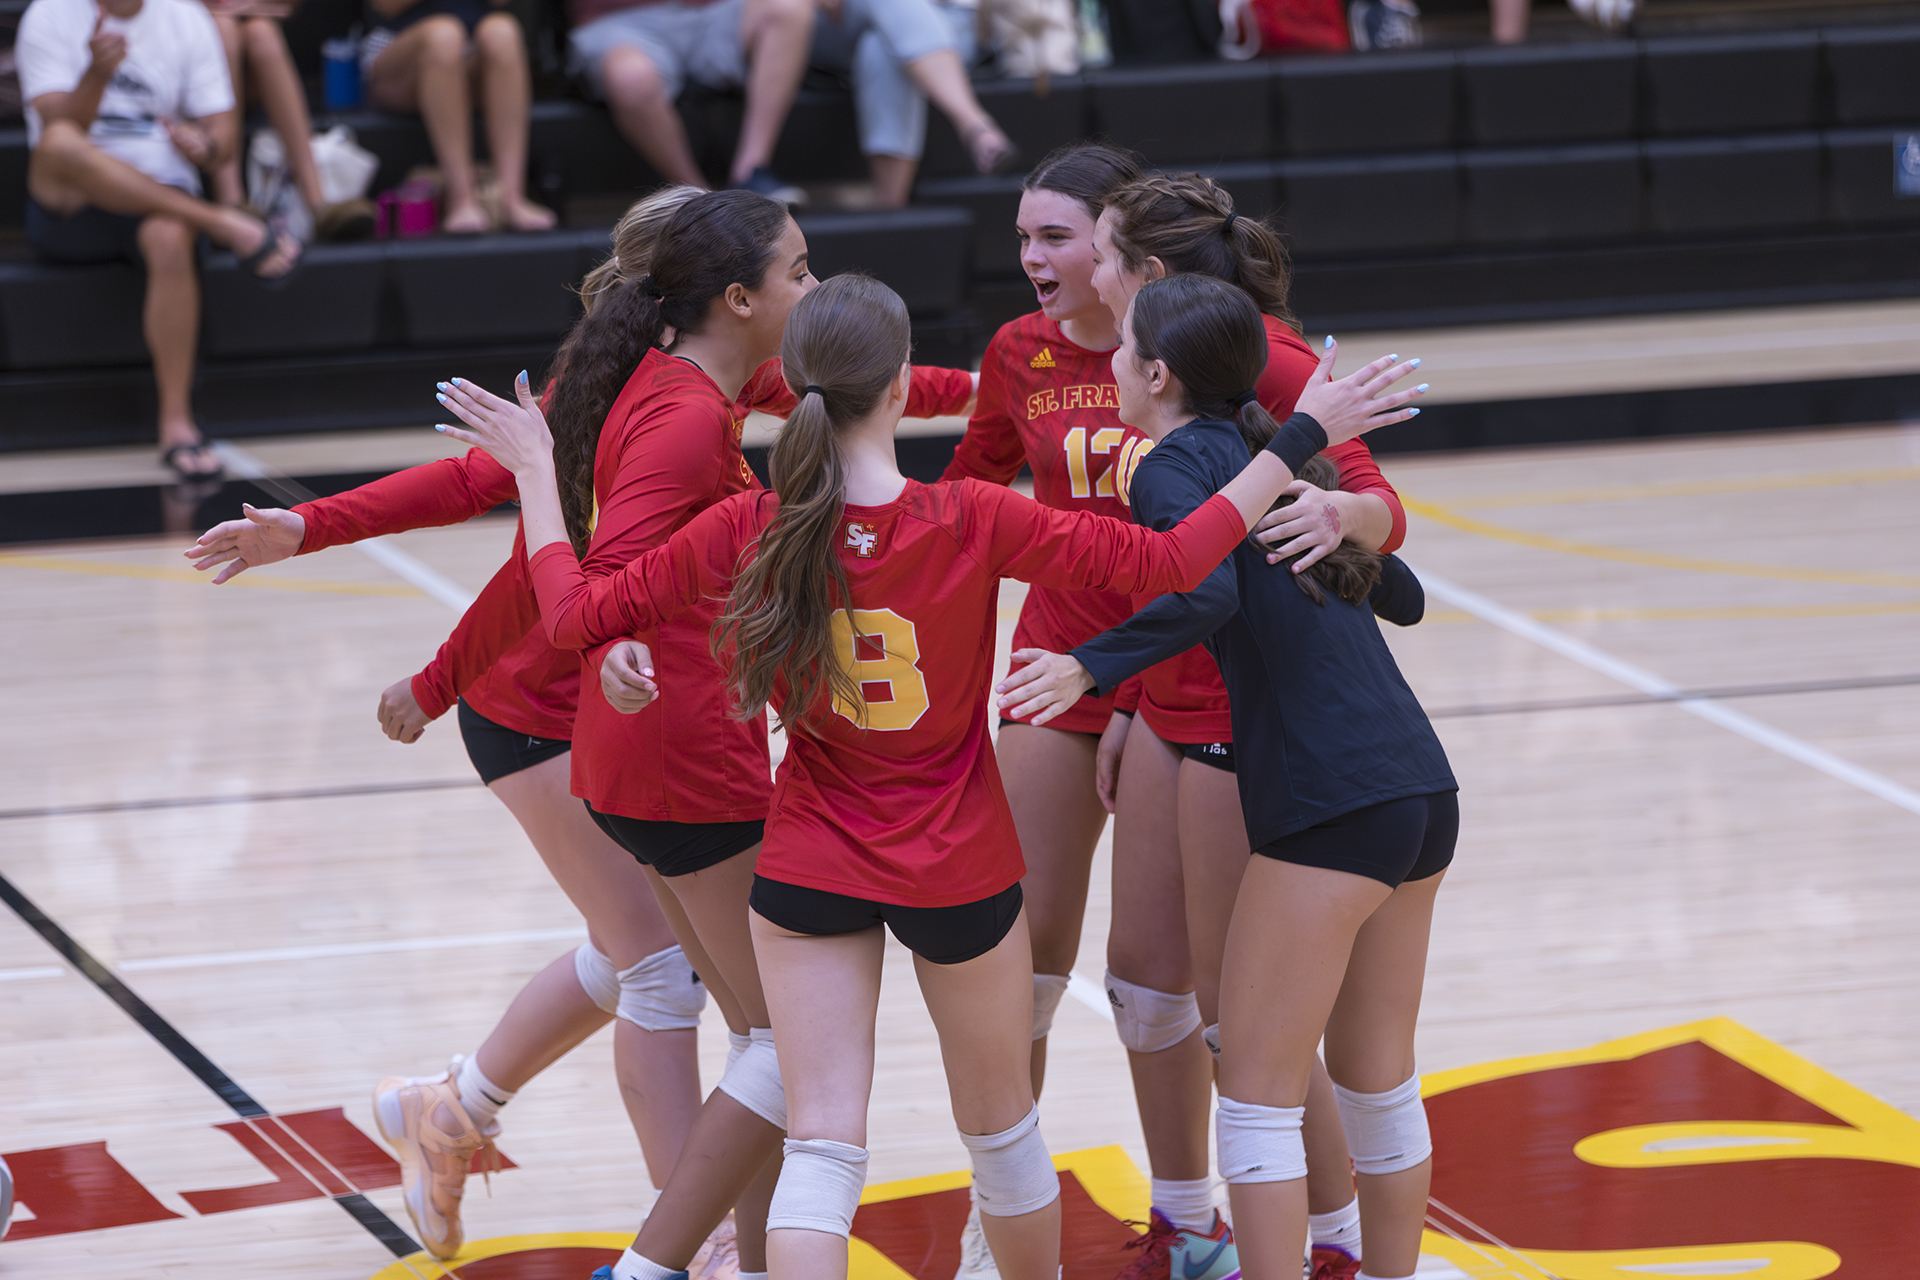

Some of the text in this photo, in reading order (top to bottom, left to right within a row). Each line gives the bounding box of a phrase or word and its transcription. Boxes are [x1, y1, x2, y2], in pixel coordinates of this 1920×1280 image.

[1030, 360, 1056, 368] adidas
[1027, 388, 1060, 420] ST.
[1064, 427, 1125, 498] 12
[844, 522, 878, 558] SF
[830, 608, 930, 731] 8
